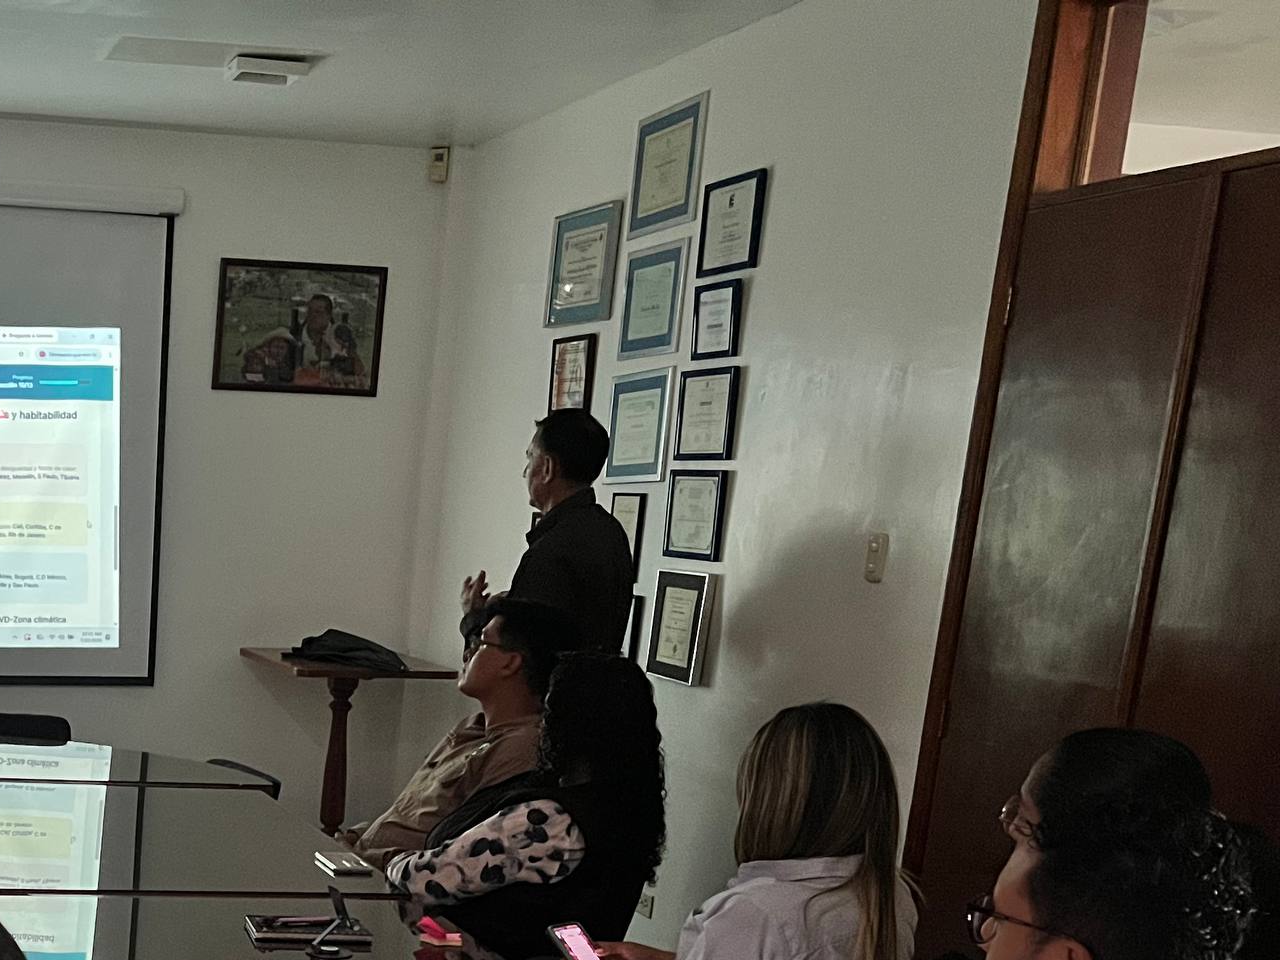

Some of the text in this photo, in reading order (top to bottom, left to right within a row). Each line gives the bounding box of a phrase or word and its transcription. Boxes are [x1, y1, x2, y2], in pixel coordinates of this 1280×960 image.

[10, 411, 18, 421] y
[18, 410, 79, 420] habitabilidad
[33, 615, 67, 625] climática
